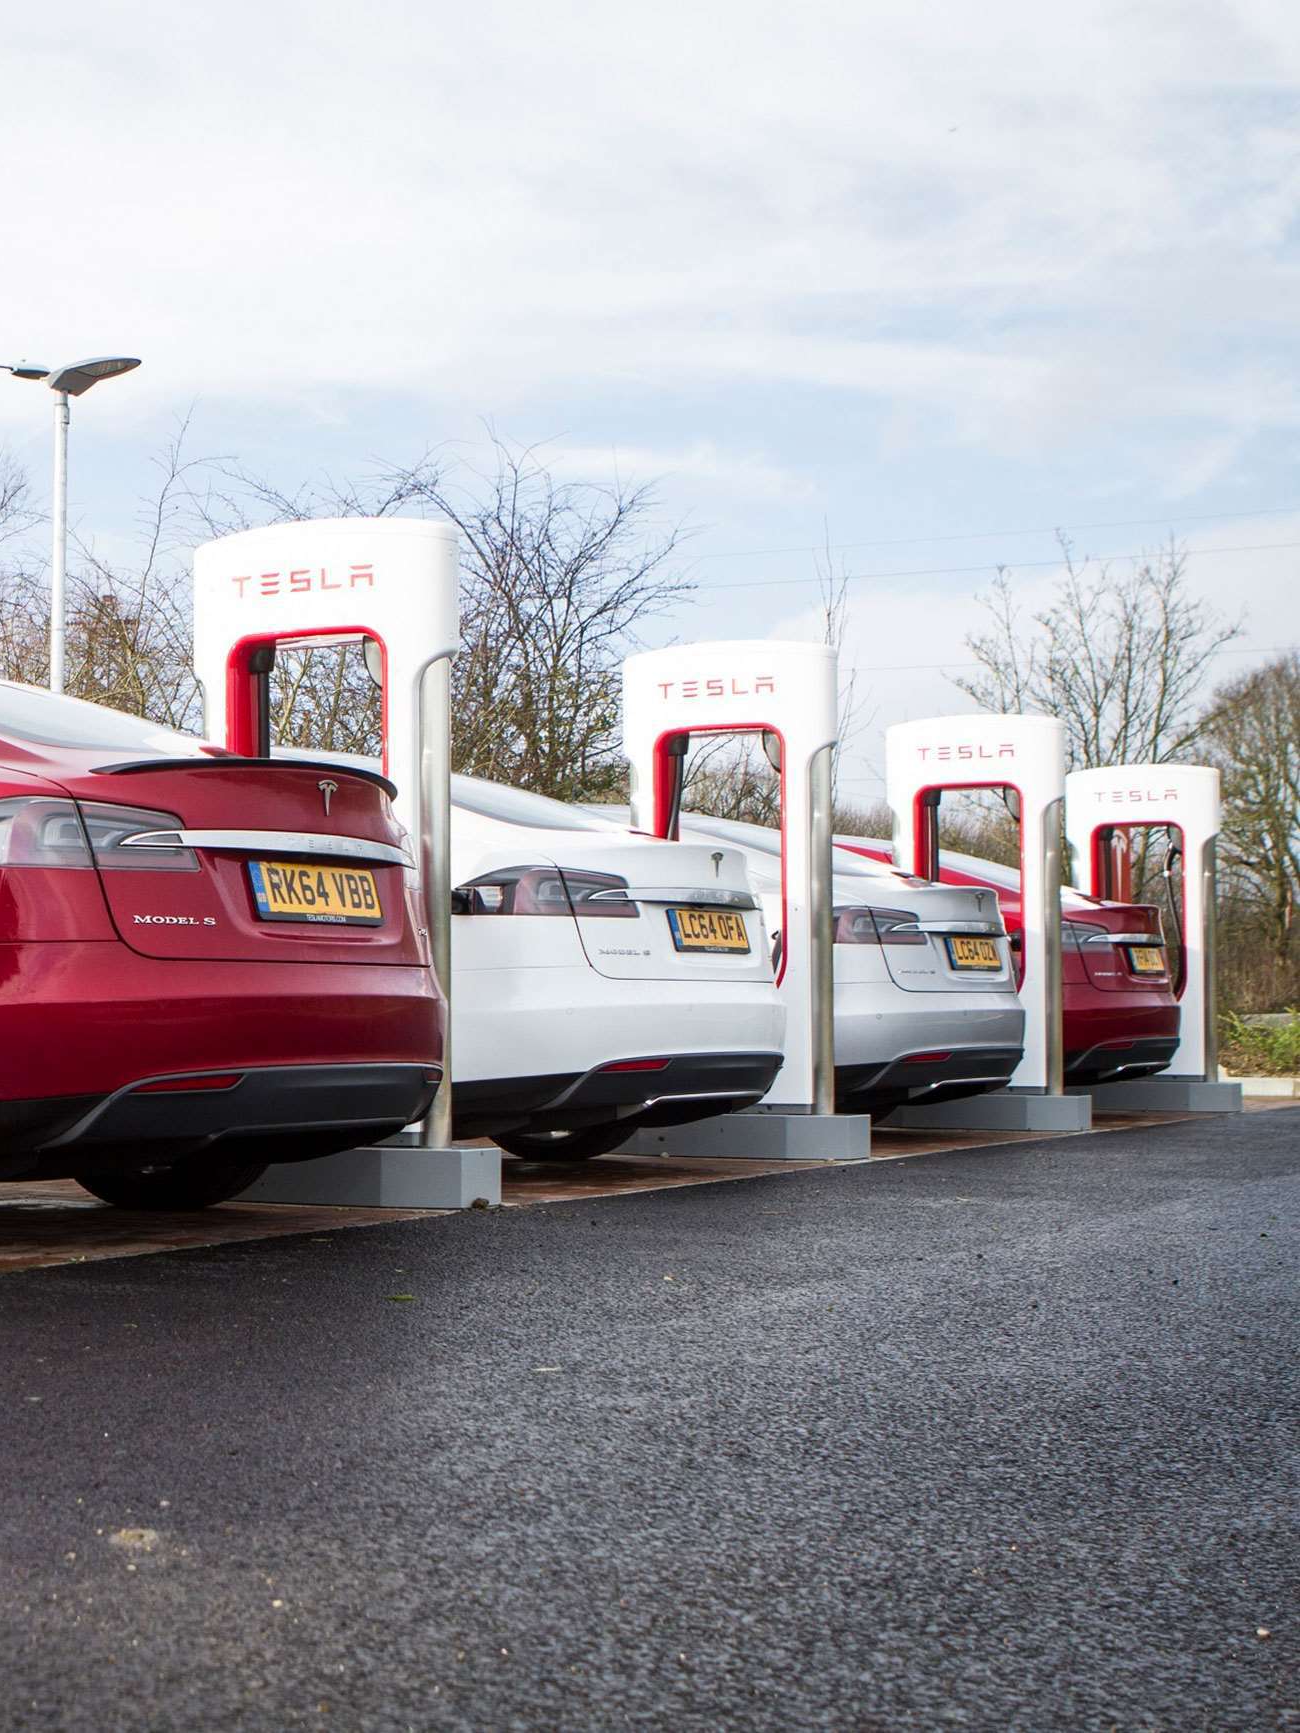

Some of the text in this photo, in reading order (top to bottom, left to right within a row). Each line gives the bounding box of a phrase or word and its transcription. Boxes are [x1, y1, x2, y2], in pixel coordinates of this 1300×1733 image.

[231, 564, 373, 598] TESLA
[657, 676, 775, 700] TESLA
[916, 743, 1014, 761] TESLA
[1093, 788, 1178, 803] TESLA
[266, 867, 376, 910] RK64 VBB
[133, 914, 217, 926] MODEL S
[678, 911, 718, 940] LC64
